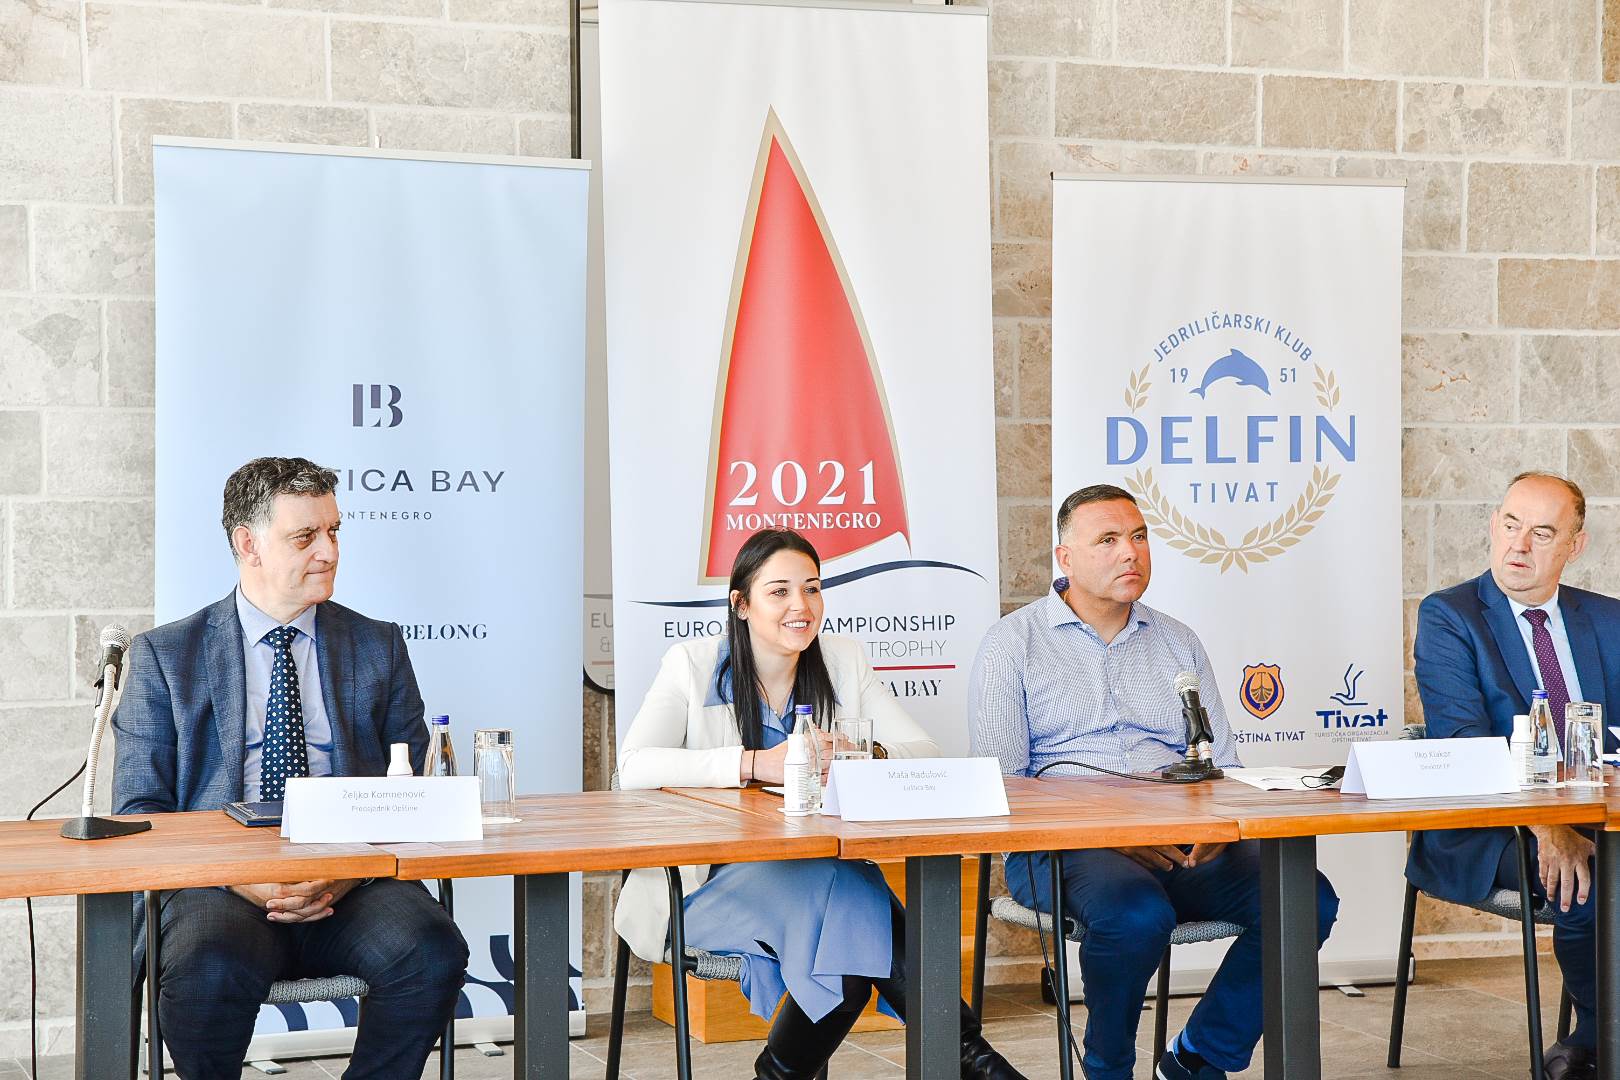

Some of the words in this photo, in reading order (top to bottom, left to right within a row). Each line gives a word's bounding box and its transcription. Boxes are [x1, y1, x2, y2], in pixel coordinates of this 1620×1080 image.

[1154, 311, 1271, 362] JEDRILIČARSKI
[1274, 326, 1312, 361] KLUB
[1170, 368, 1188, 383] 19
[1280, 368, 1296, 383] 51
[1106, 415, 1356, 465] DELFIN
[431, 470, 505, 492] BAY
[729, 460, 876, 506] 2021
[1190, 482, 1279, 503] TIVAT
[727, 511, 881, 530] MONTENEGRO
[400, 623, 487, 641] BELONG
[664, 620, 728, 638] EURO
[866, 639, 947, 657] TROPHY
[905, 680, 942, 698] BAY
[1315, 709, 1388, 728] Tivat
[1275, 731, 1305, 742] TIVAT
